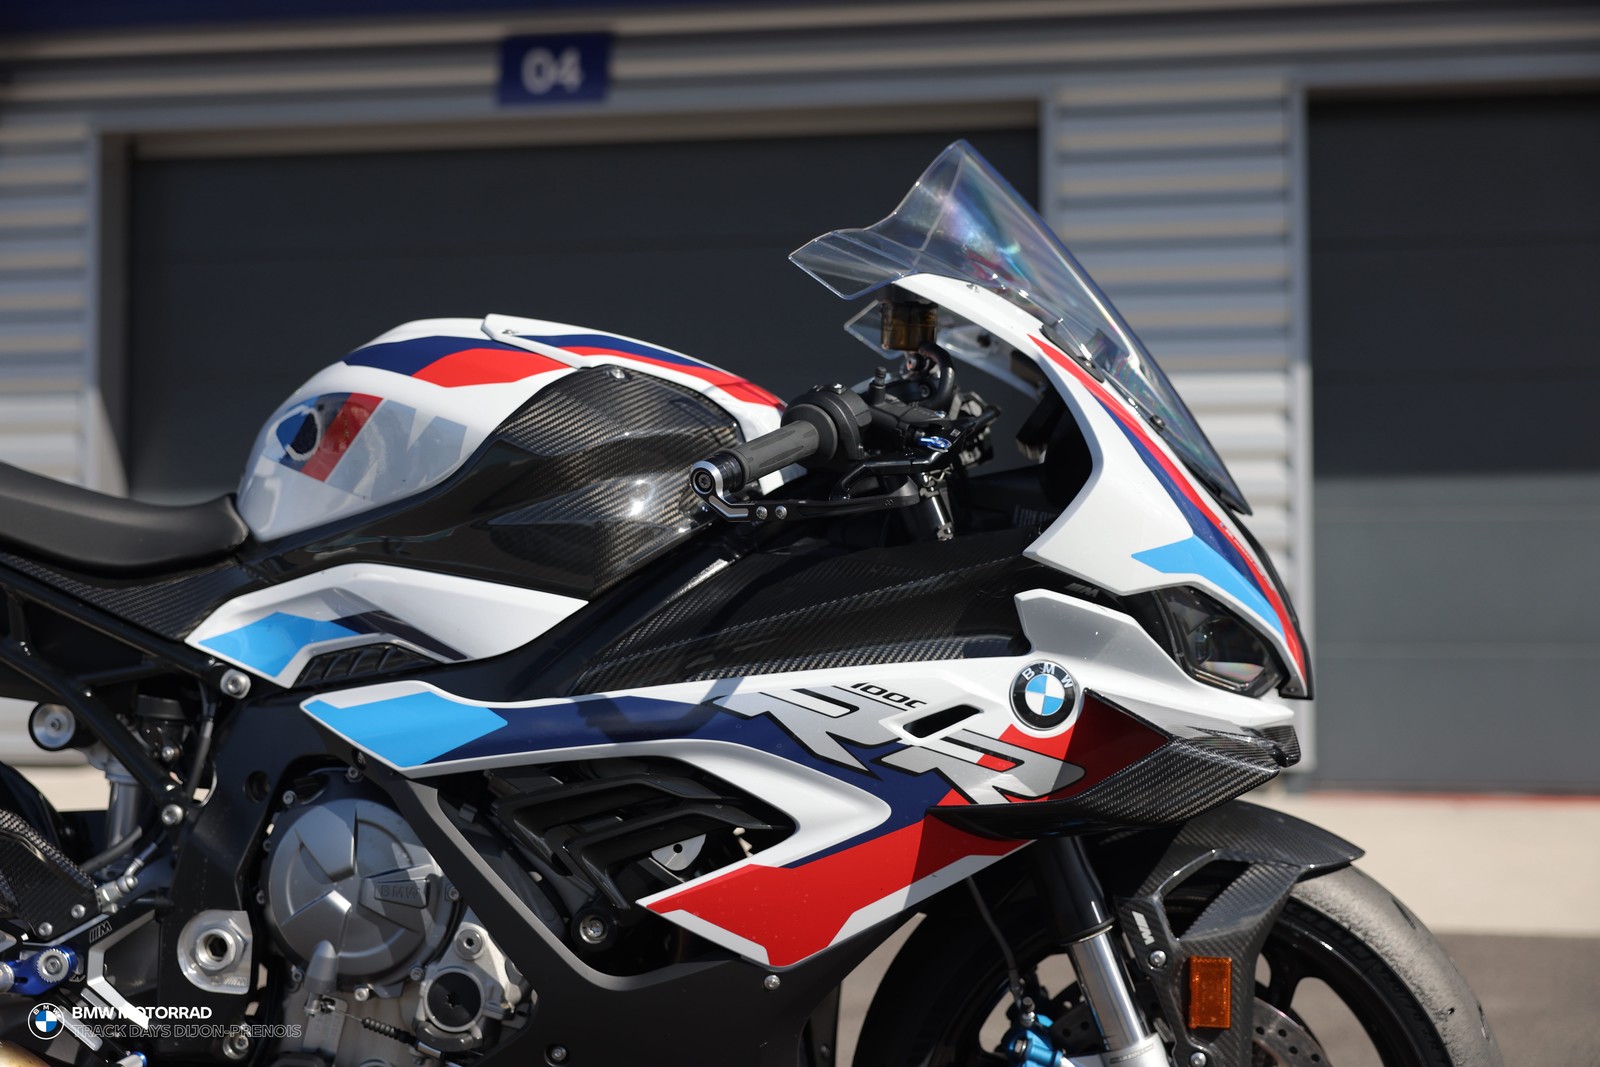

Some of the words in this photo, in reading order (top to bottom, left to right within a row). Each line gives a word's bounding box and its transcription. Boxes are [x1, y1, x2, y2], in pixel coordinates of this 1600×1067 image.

[521, 47, 585, 94] 04
[1021, 662, 1074, 689] BMW
[380, 884, 420, 900] BMW
